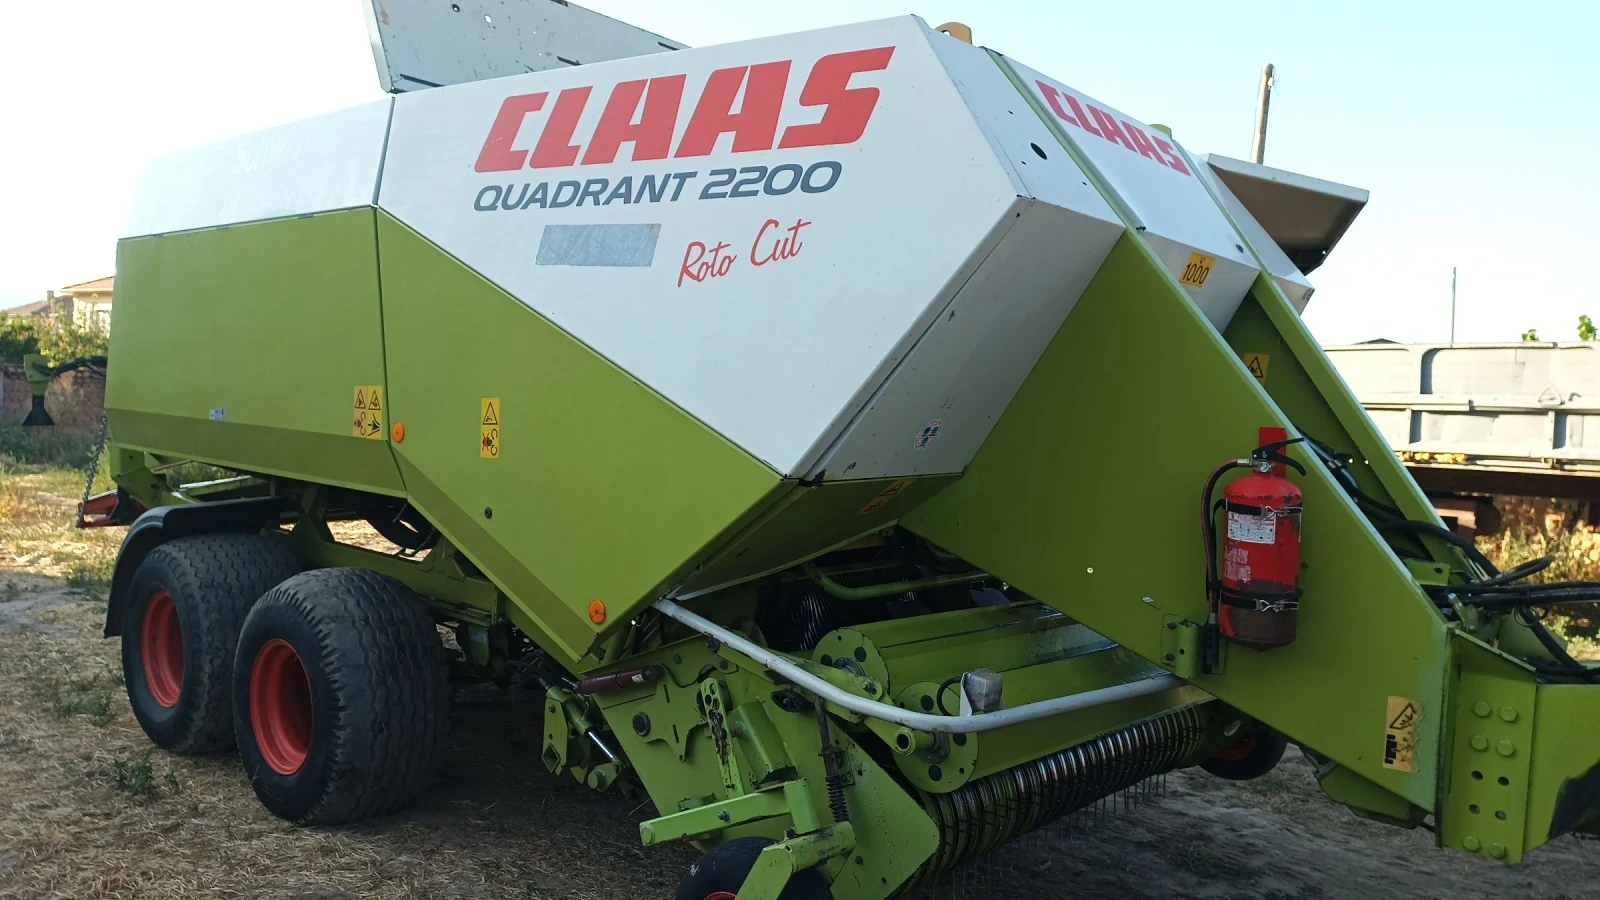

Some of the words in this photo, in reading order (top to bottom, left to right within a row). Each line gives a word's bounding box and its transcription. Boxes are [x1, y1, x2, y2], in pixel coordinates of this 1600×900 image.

[473, 45, 896, 173] CLAAS
[1035, 79, 1192, 177] CLAAS
[473, 170, 699, 212] QUADRANT
[699, 160, 843, 201] 2200
[677, 240, 737, 288] Roto
[750, 218, 812, 267] Cut
[1182, 262, 1210, 285] 1000
